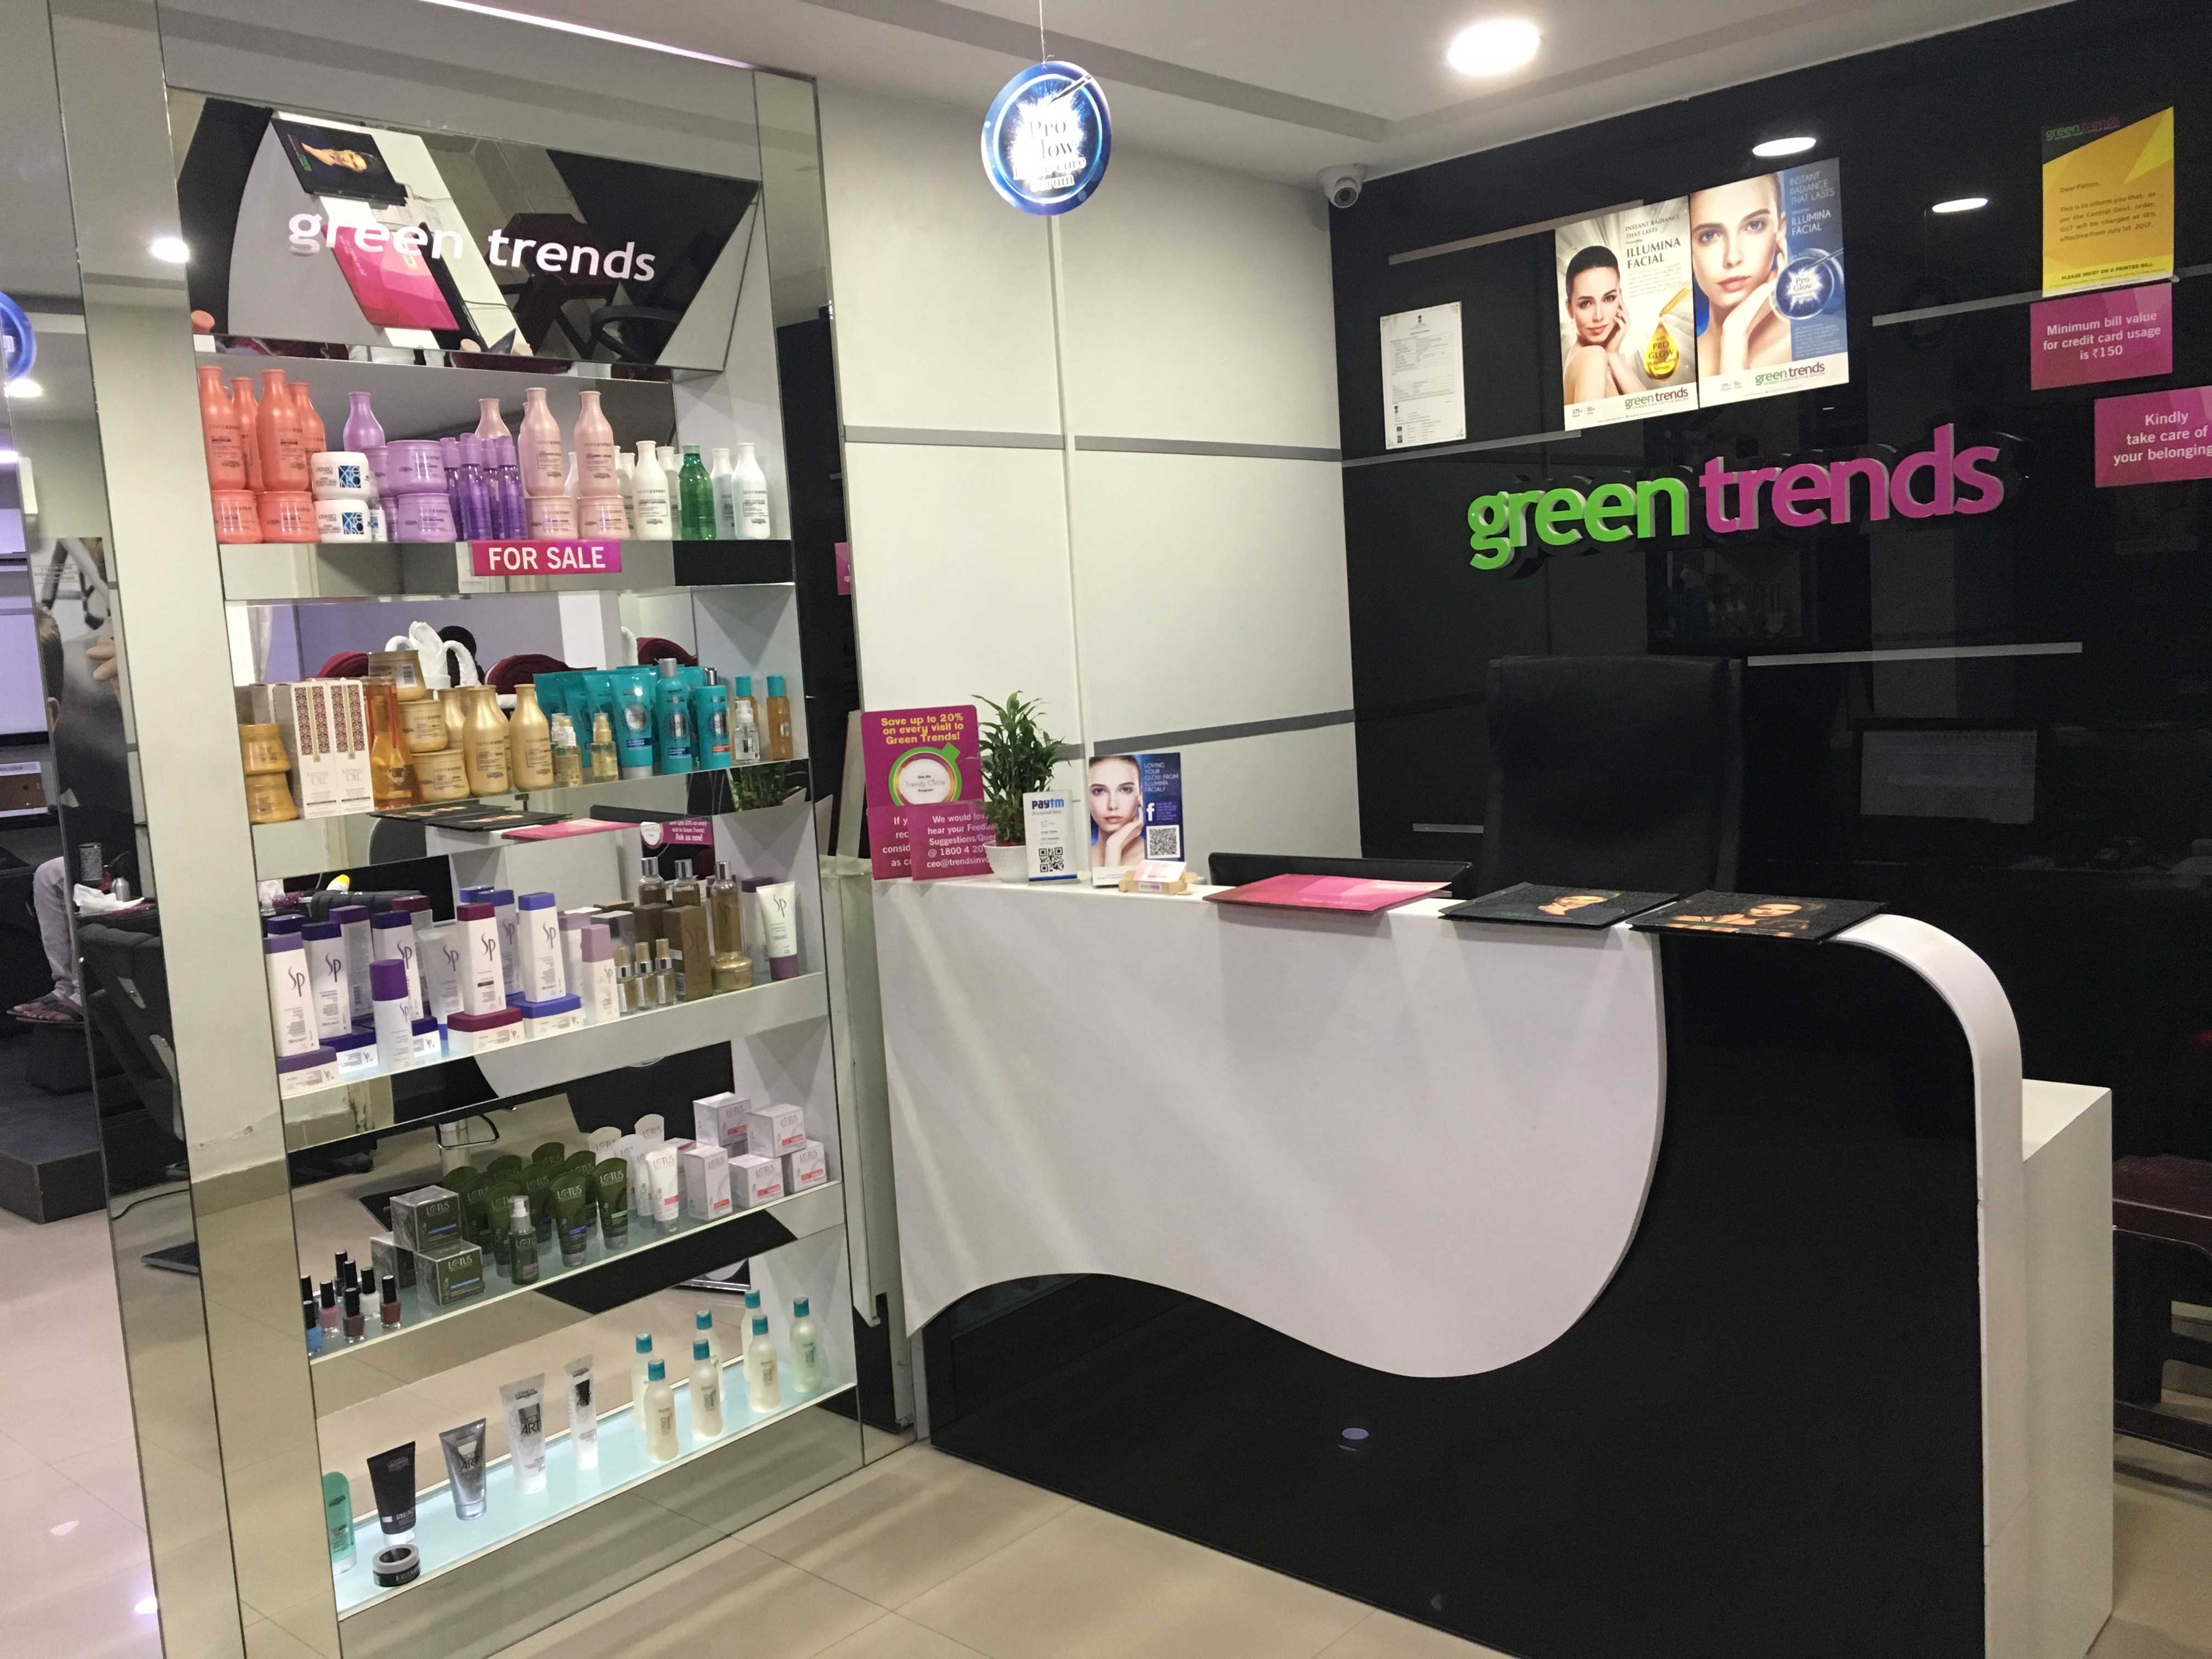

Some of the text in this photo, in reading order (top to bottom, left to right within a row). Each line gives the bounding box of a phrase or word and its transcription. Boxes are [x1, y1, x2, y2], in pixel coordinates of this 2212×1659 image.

[1030, 121, 1066, 137] Pro
[2046, 125, 2080, 141] green
[1041, 139, 1073, 159] low
[1790, 171, 1821, 185] INSTANT
[1790, 180, 1829, 195] RADIANCE
[1791, 188, 1835, 205] THAT LASTS
[2090, 198, 2112, 207] inform
[2114, 197, 2126, 205] you
[1791, 210, 1831, 225] ILLUMINA
[2086, 209, 2111, 218] Central
[2101, 215, 2130, 227] charged
[1626, 215, 1680, 232] INSTANT RADIANCE
[1792, 223, 1822, 236] FACIAL
[2059, 232, 2089, 242] effective
[2107, 226, 2121, 235] July
[289, 213, 655, 281] green trends
[1627, 238, 1681, 258] ILLUMINA
[1627, 253, 1664, 269] FACIAL
[1793, 283, 1813, 292] Glow
[1796, 276, 1810, 286] Pro
[2047, 312, 2157, 335] Minimum bill value
[1653, 340, 1669, 350] PRO
[2043, 326, 2162, 351] for credit card usage
[1649, 349, 1674, 359] GLOW
[2080, 345, 2123, 360] is ₹150
[1755, 370, 1787, 386] green
[1789, 362, 1825, 377] trends
[1625, 395, 1654, 410] green
[1655, 387, 1689, 402] trends
[2145, 411, 2188, 426] Kindly
[2126, 425, 2208, 445] take care of
[2113, 452, 2143, 466] your
[1468, 423, 2004, 570] green trends
[488, 546, 606, 570] FOR SALE
[881, 718, 906, 726] Save
[910, 717, 924, 725] up
[940, 713, 963, 722] 20%
[899, 726, 928, 735] every
[932, 723, 951, 731] visit
[886, 732, 960, 745] Green Trends!
[905, 781, 926, 789] Trendy
[1032, 799, 1064, 809] paytm
[894, 816, 900, 825] If
[948, 814, 971, 822] would
[974, 812, 988, 821] lov
[947, 827, 964, 835] your
[928, 849, 937, 858] @
[940, 846, 962, 856] 1800
[521, 1420, 541, 1435] ART
[460, 1455, 479, 1472] ART
